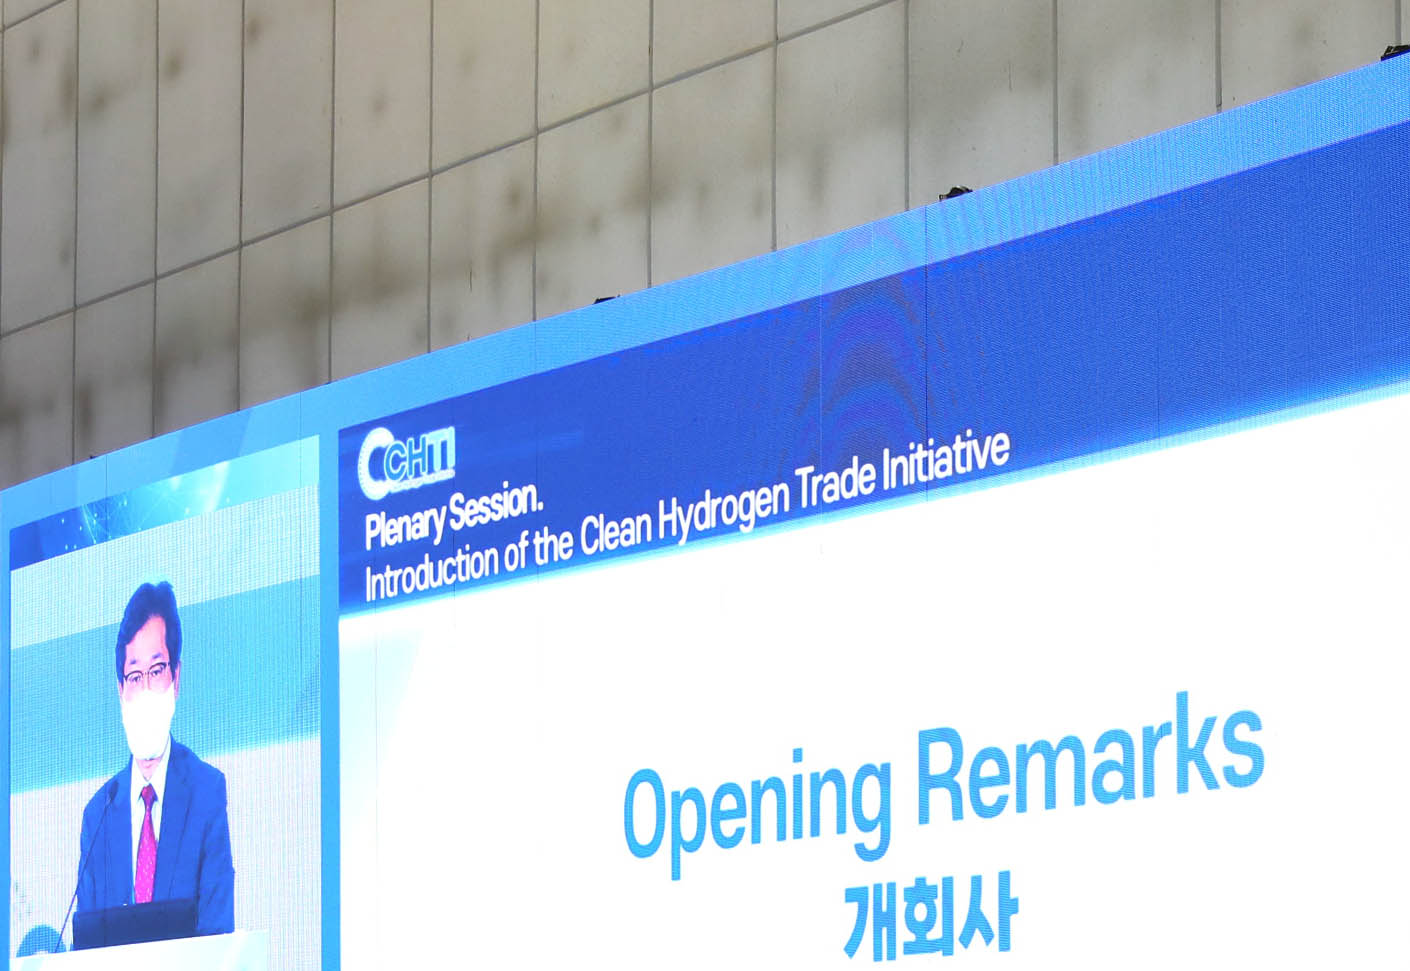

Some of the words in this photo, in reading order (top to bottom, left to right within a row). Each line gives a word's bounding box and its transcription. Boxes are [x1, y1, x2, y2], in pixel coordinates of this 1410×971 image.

[383, 426, 455, 483] CHTI
[364, 543, 502, 602] Introduction
[503, 530, 532, 571] of
[533, 526, 574, 566] the
[580, 508, 653, 557] Clean
[657, 482, 791, 546] Hydrogen
[794, 454, 878, 510] Trade
[882, 429, 1012, 492] Initiative
[365, 504, 447, 551] Plenary
[449, 480, 545, 531] Session.
[623, 747, 892, 881] Opening
[917, 690, 1266, 826] Remarks
[842, 869, 1020, 963] 개회사
